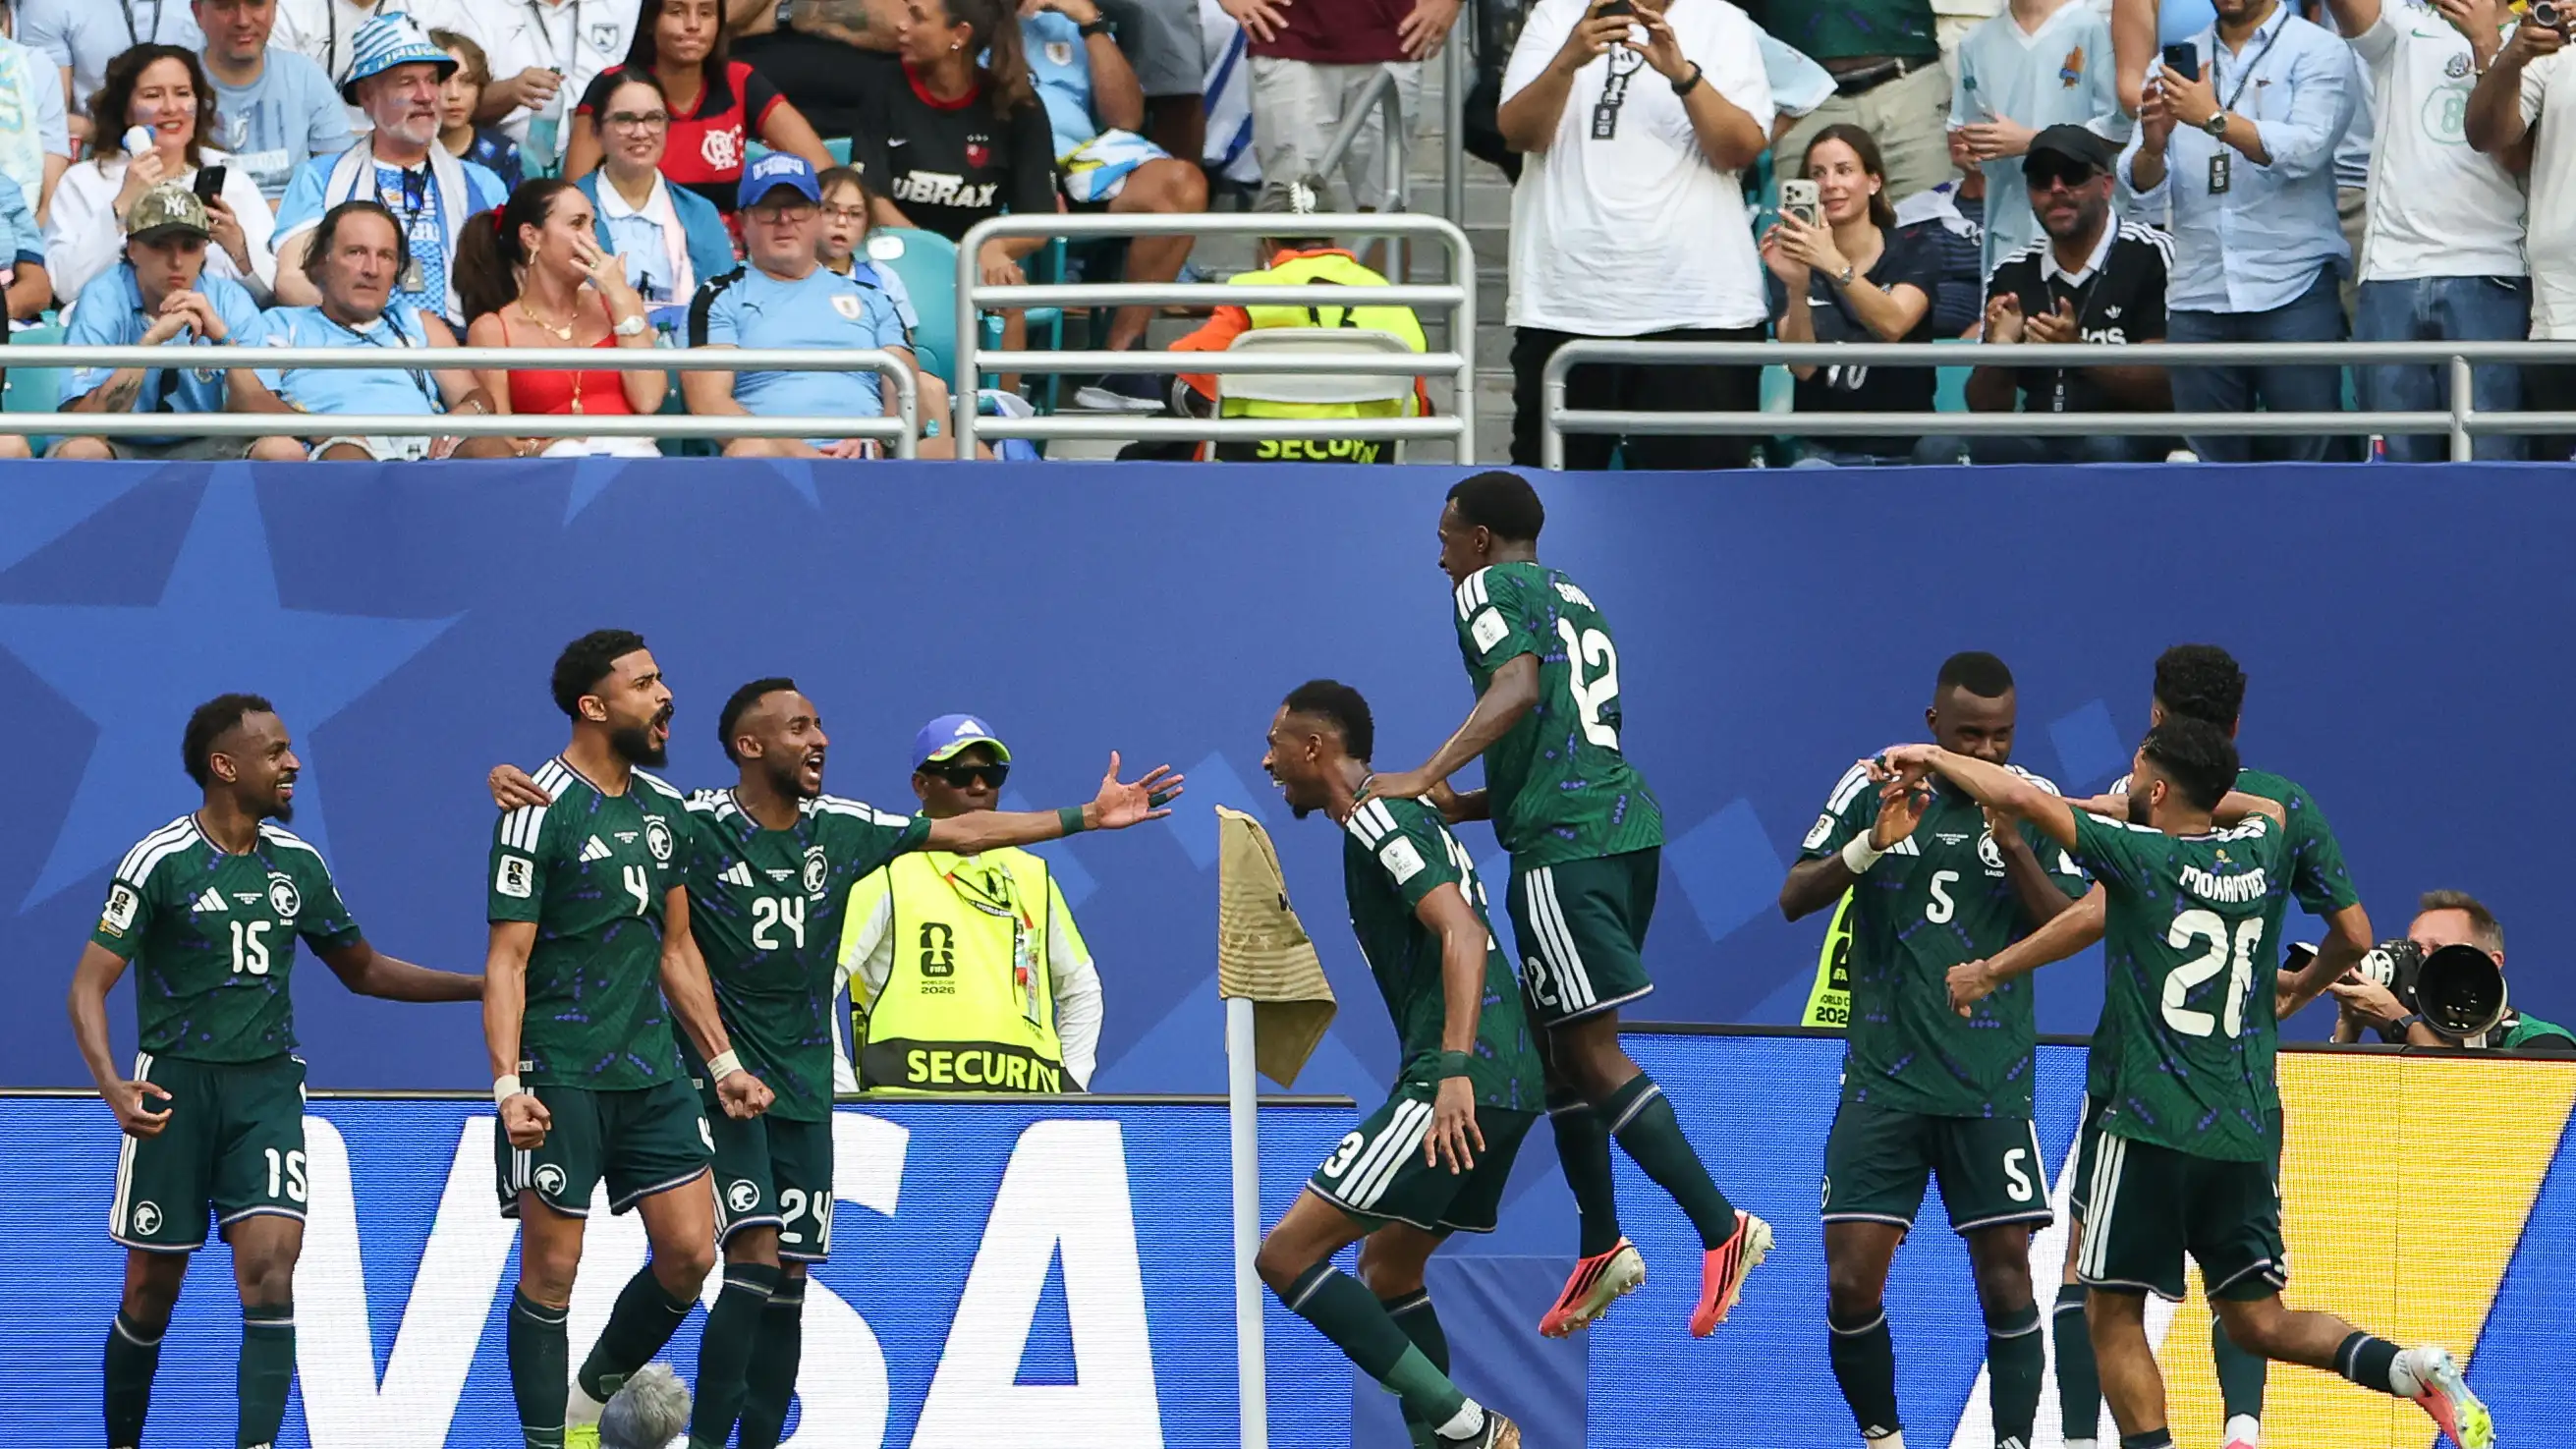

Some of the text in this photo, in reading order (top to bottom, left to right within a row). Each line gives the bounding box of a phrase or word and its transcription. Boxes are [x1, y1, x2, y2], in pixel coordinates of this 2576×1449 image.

[892, 169, 998, 208] UBRAX
[1558, 617, 1620, 751] 12
[624, 864, 649, 917] 4
[1927, 870, 1960, 923] 5
[230, 920, 271, 975] 15
[752, 895, 805, 950] 24
[1816, 1006, 1849, 1024] 202
[264, 1147, 307, 1203] 15
[1316, 1131, 1365, 1179] 3
[2004, 1147, 2033, 1201] 5
[780, 1188, 831, 1244] 24
